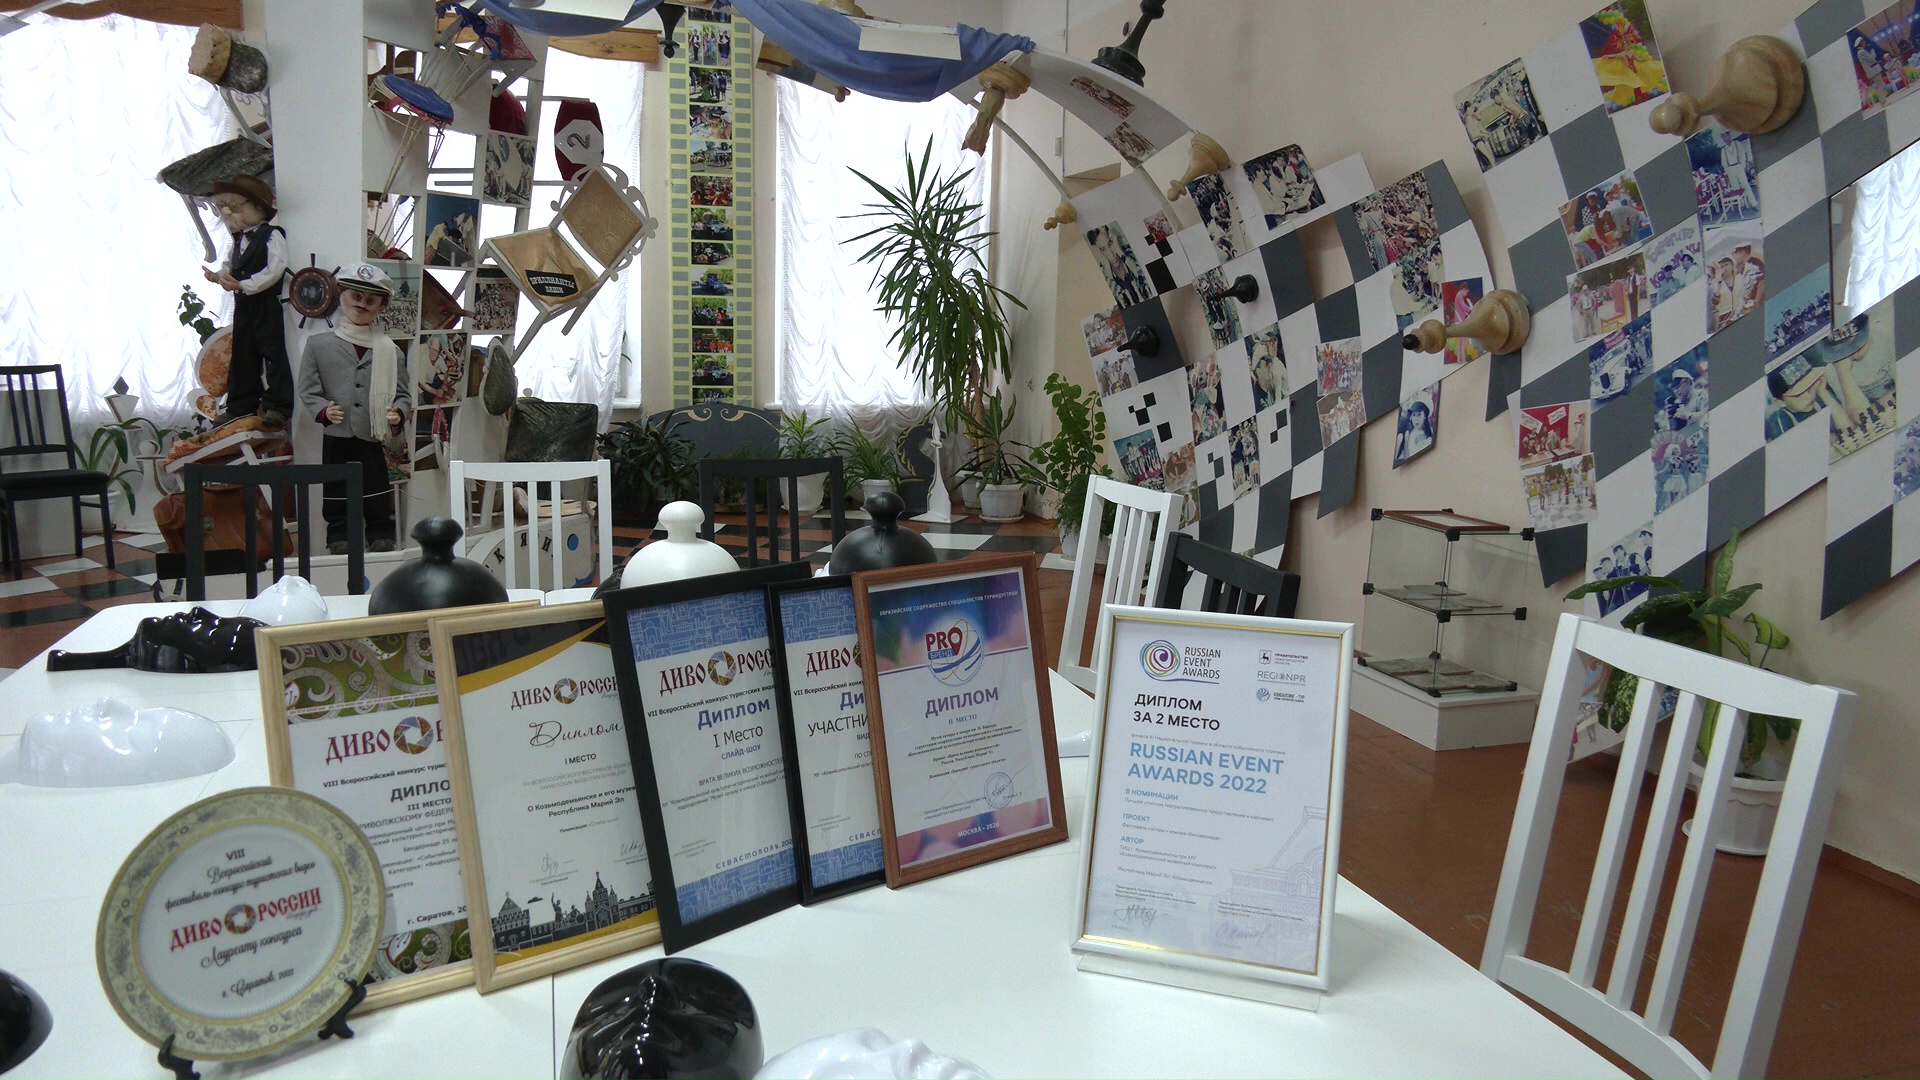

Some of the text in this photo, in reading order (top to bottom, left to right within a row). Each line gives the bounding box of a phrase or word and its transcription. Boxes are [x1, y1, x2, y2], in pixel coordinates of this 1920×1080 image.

[566, 132, 591, 150] 2
[926, 627, 963, 655] PRO
[1184, 646, 1222, 659] RUSSIAN
[806, 647, 850, 678] ДИВО
[1184, 657, 1212, 668] EVENT
[660, 662, 706, 696] ДИВО
[1182, 668, 1220, 680] AWARDS
[804, 682, 848, 694] Всероссийский
[511, 686, 552, 710] ДИВО
[647, 688, 761, 718] VII Всероссийский конкурс туристских
[925, 687, 999, 718] ДИПЛОМ
[1134, 693, 1202, 711] ДИПЛОМ
[698, 698, 770, 730] Диплом
[956, 714, 977, 724] МЕСТО
[1133, 710, 1220, 731] ЗА 2 МЕСТО
[529, 720, 624, 748] Диплом
[714, 726, 764, 748] I Место
[326, 728, 390, 766] ДИВО
[721, 744, 762, 760] СЛАЙД-ШОУ
[569, 753, 597, 764] МЕСТО
[1130, 742, 1284, 775] RUSSIAN EVENT
[323, 779, 338, 788] VIII
[340, 770, 395, 786] Всероссийский
[397, 766, 426, 778] конкурс
[1128, 763, 1267, 794] AWARDS 2022
[535, 794, 598, 811] Козьмодемьянске
[1132, 789, 1179, 800] НОМИНАЦИИ
[407, 797, 452, 812] III МЕСТО
[548, 796, 624, 818] Республика Марий Эл
[1122, 813, 1150, 822] ПРОЕКТ
[368, 827, 413, 840] ормационный
[958, 826, 982, 838] МОСКВА
[1121, 836, 1144, 844] АВТОР
[226, 848, 245, 861] VIII
[170, 887, 322, 952] ДИВО РОССИИ
[416, 908, 454, 922] Саратов,
[200, 926, 302, 968] Лауреату конкурса
